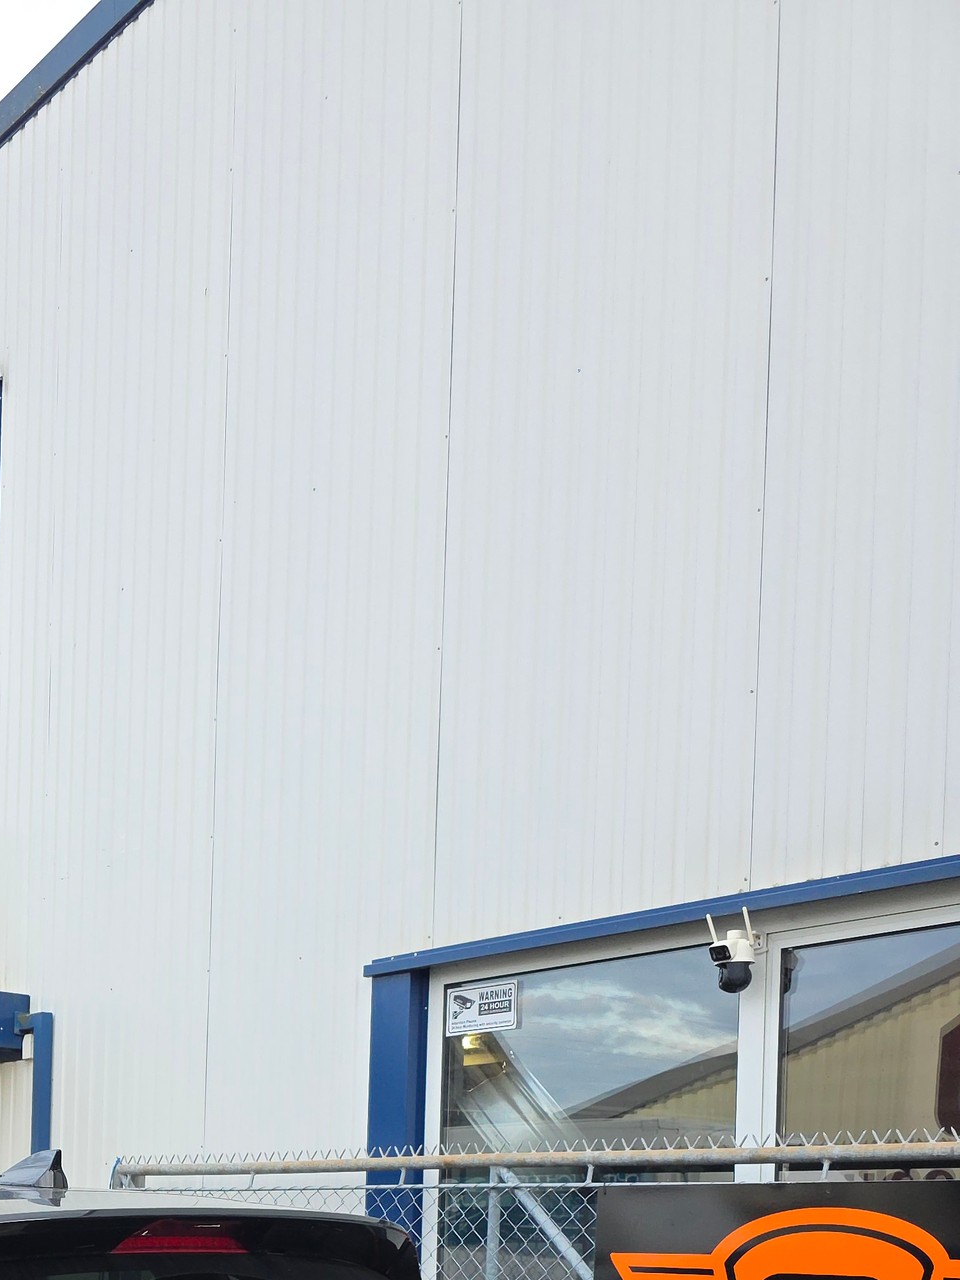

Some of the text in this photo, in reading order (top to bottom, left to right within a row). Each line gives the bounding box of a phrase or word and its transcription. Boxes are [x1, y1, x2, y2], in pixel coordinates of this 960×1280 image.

[479, 988, 513, 1001] WARNING
[480, 1001, 510, 1011] 24 HOUR
